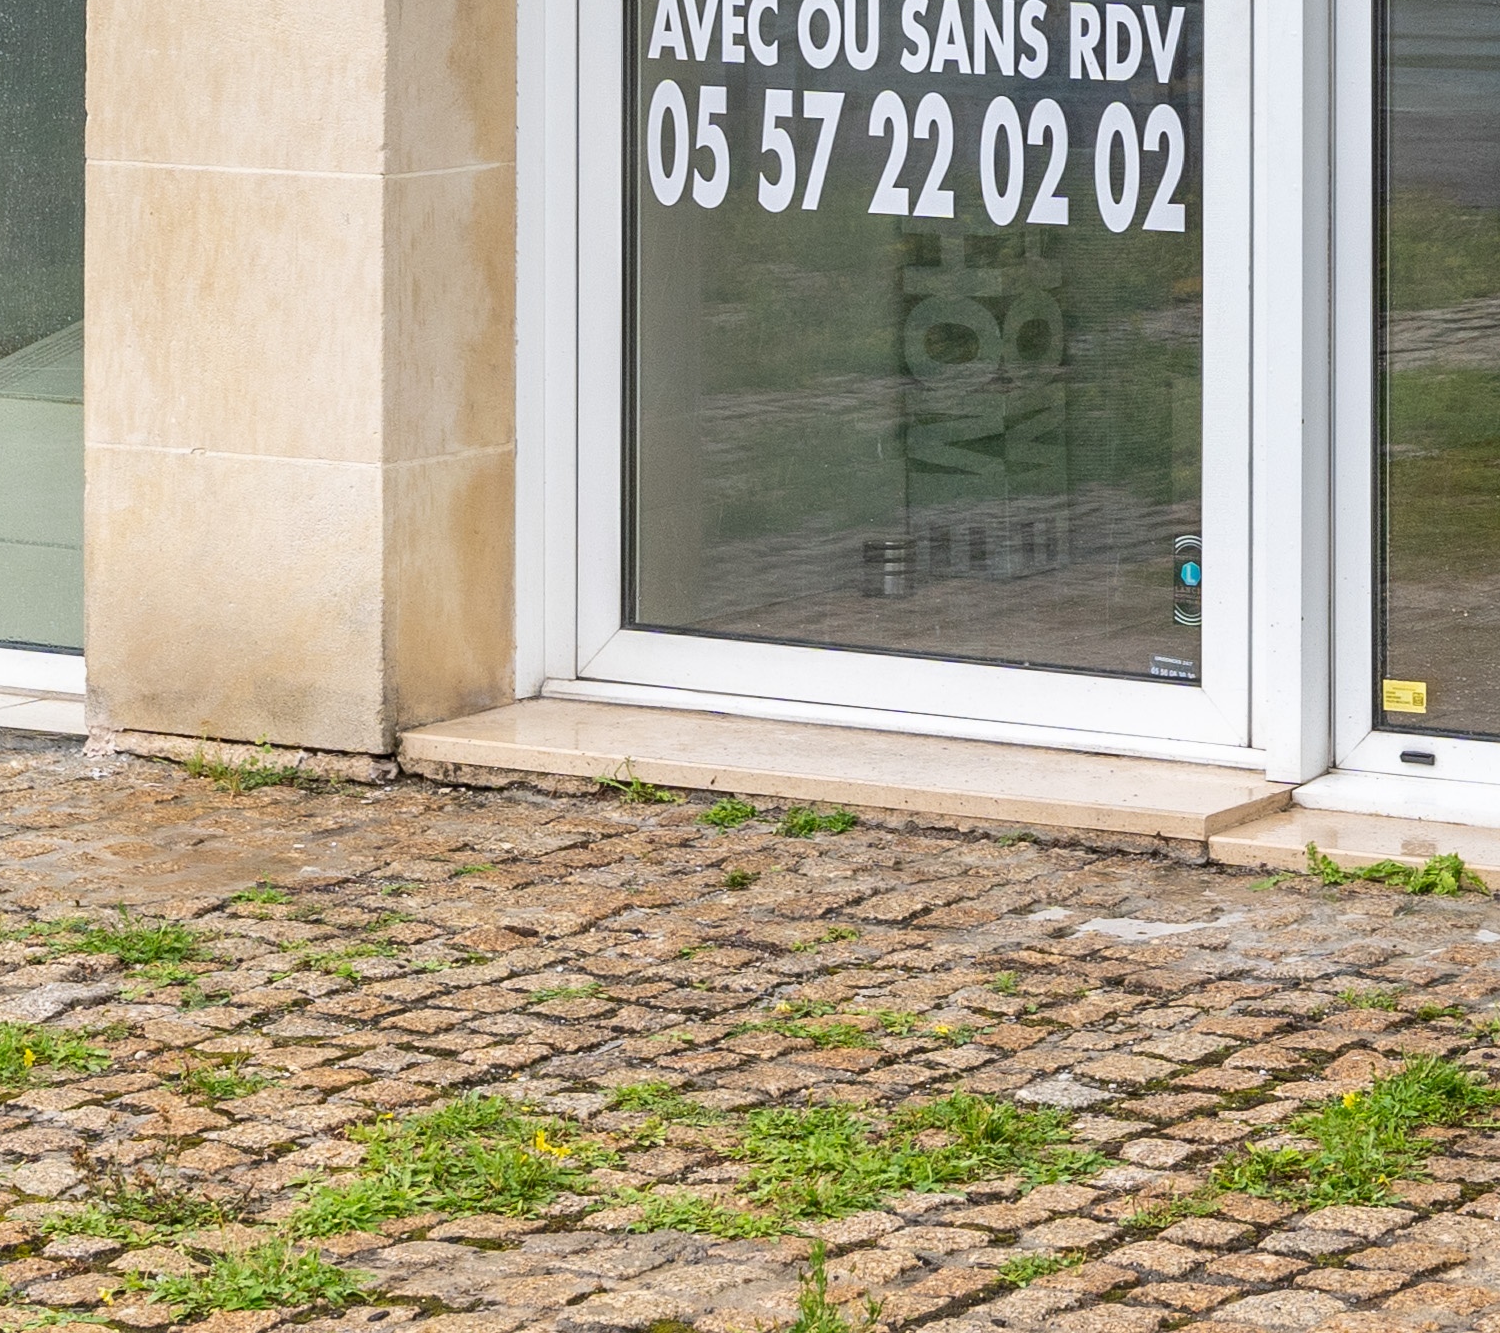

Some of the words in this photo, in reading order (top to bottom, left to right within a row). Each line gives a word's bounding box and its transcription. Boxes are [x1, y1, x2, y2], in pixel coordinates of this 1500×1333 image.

[1068, 0, 1187, 85] RDV
[645, 78, 731, 210] 05
[756, 87, 847, 214] 57
[866, 88, 956, 220] 22
[978, 94, 1070, 228] 02
[1093, 100, 1187, 234] 02
